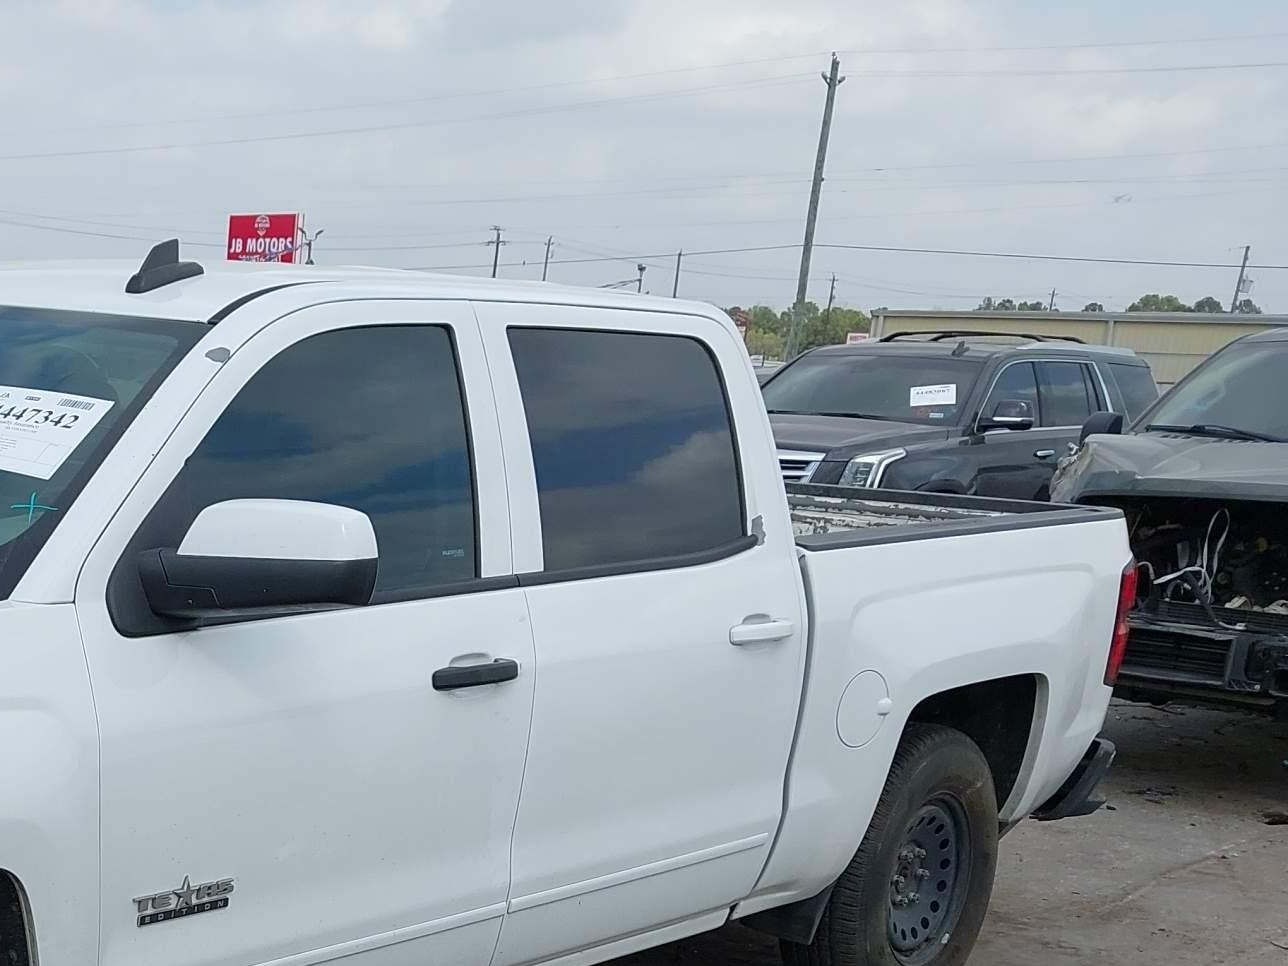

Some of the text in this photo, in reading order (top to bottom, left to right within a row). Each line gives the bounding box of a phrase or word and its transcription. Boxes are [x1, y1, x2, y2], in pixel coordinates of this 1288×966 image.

[230, 237, 293, 254] JB MOTORS
[144, 899, 225, 923] EDITION
